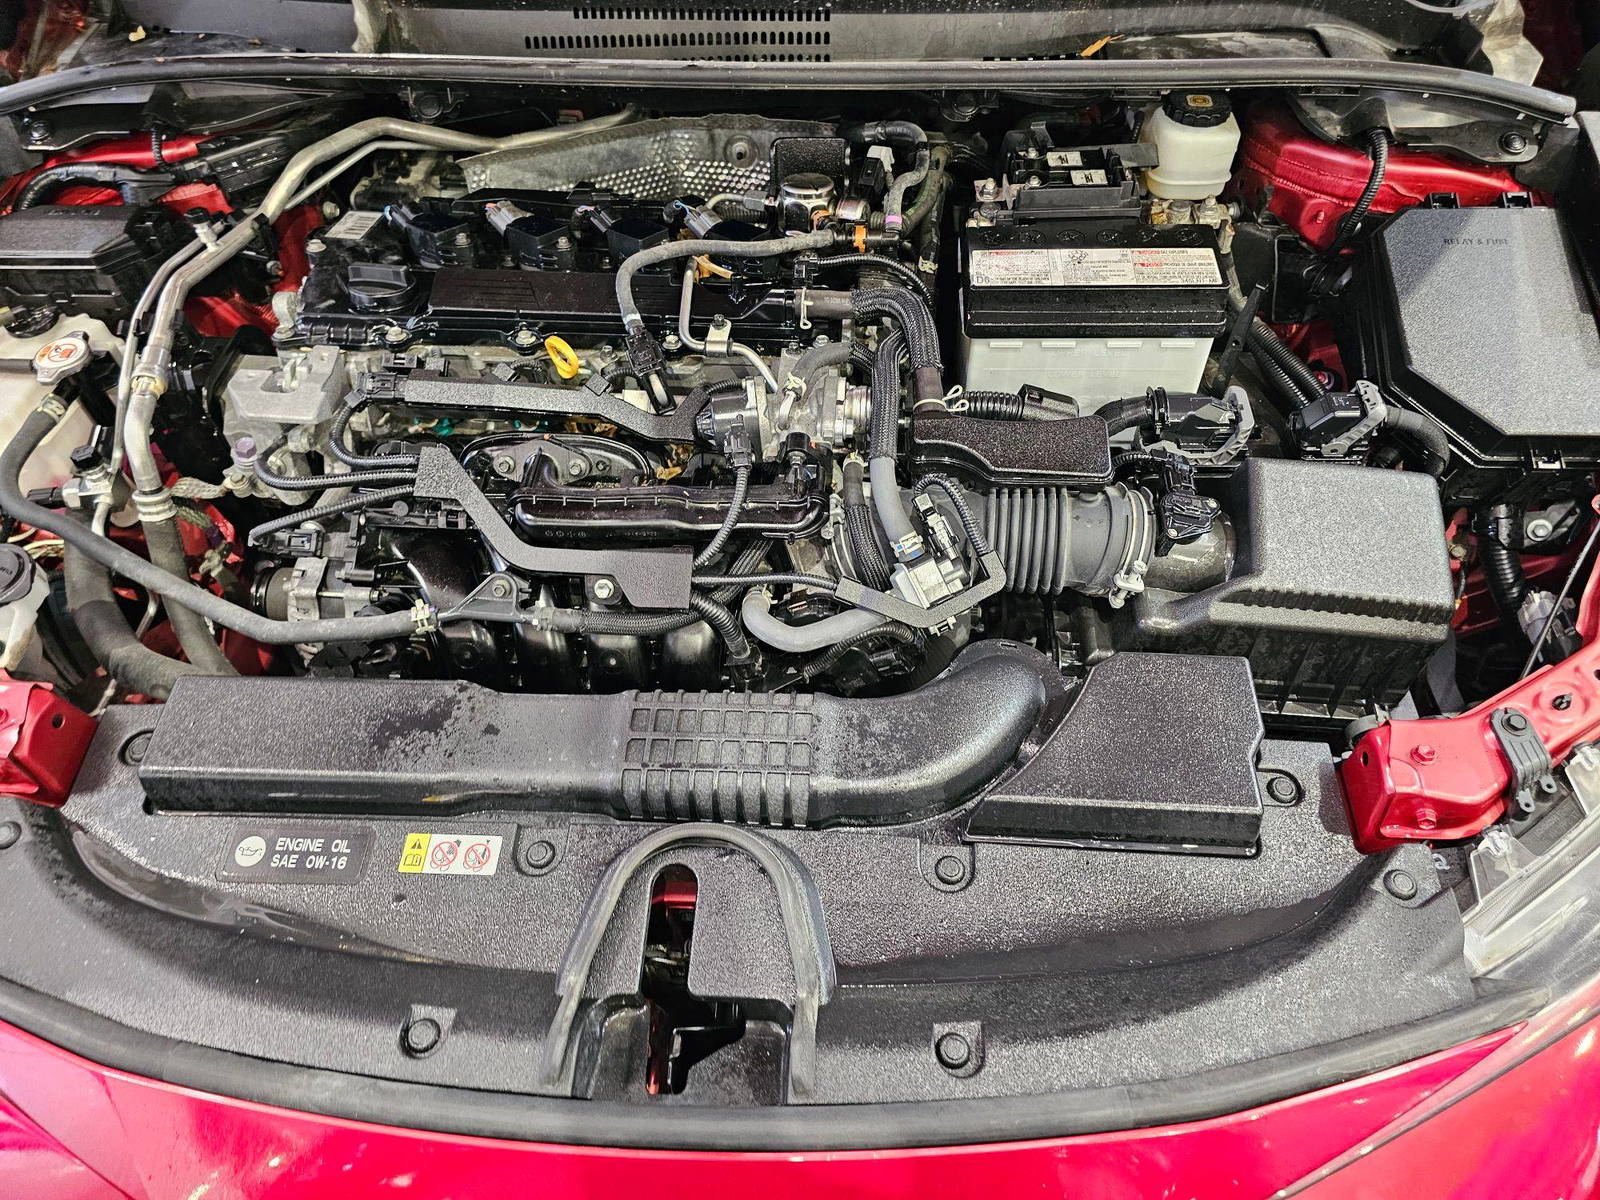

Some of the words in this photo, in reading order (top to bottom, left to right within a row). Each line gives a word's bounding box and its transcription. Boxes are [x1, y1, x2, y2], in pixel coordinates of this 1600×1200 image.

[1443, 238, 1474, 246] RELAY
[275, 837, 325, 852] ENGINE
[331, 839, 351, 853] OIL
[270, 853, 299, 868] SAE
[305, 855, 348, 870] 0W-16
